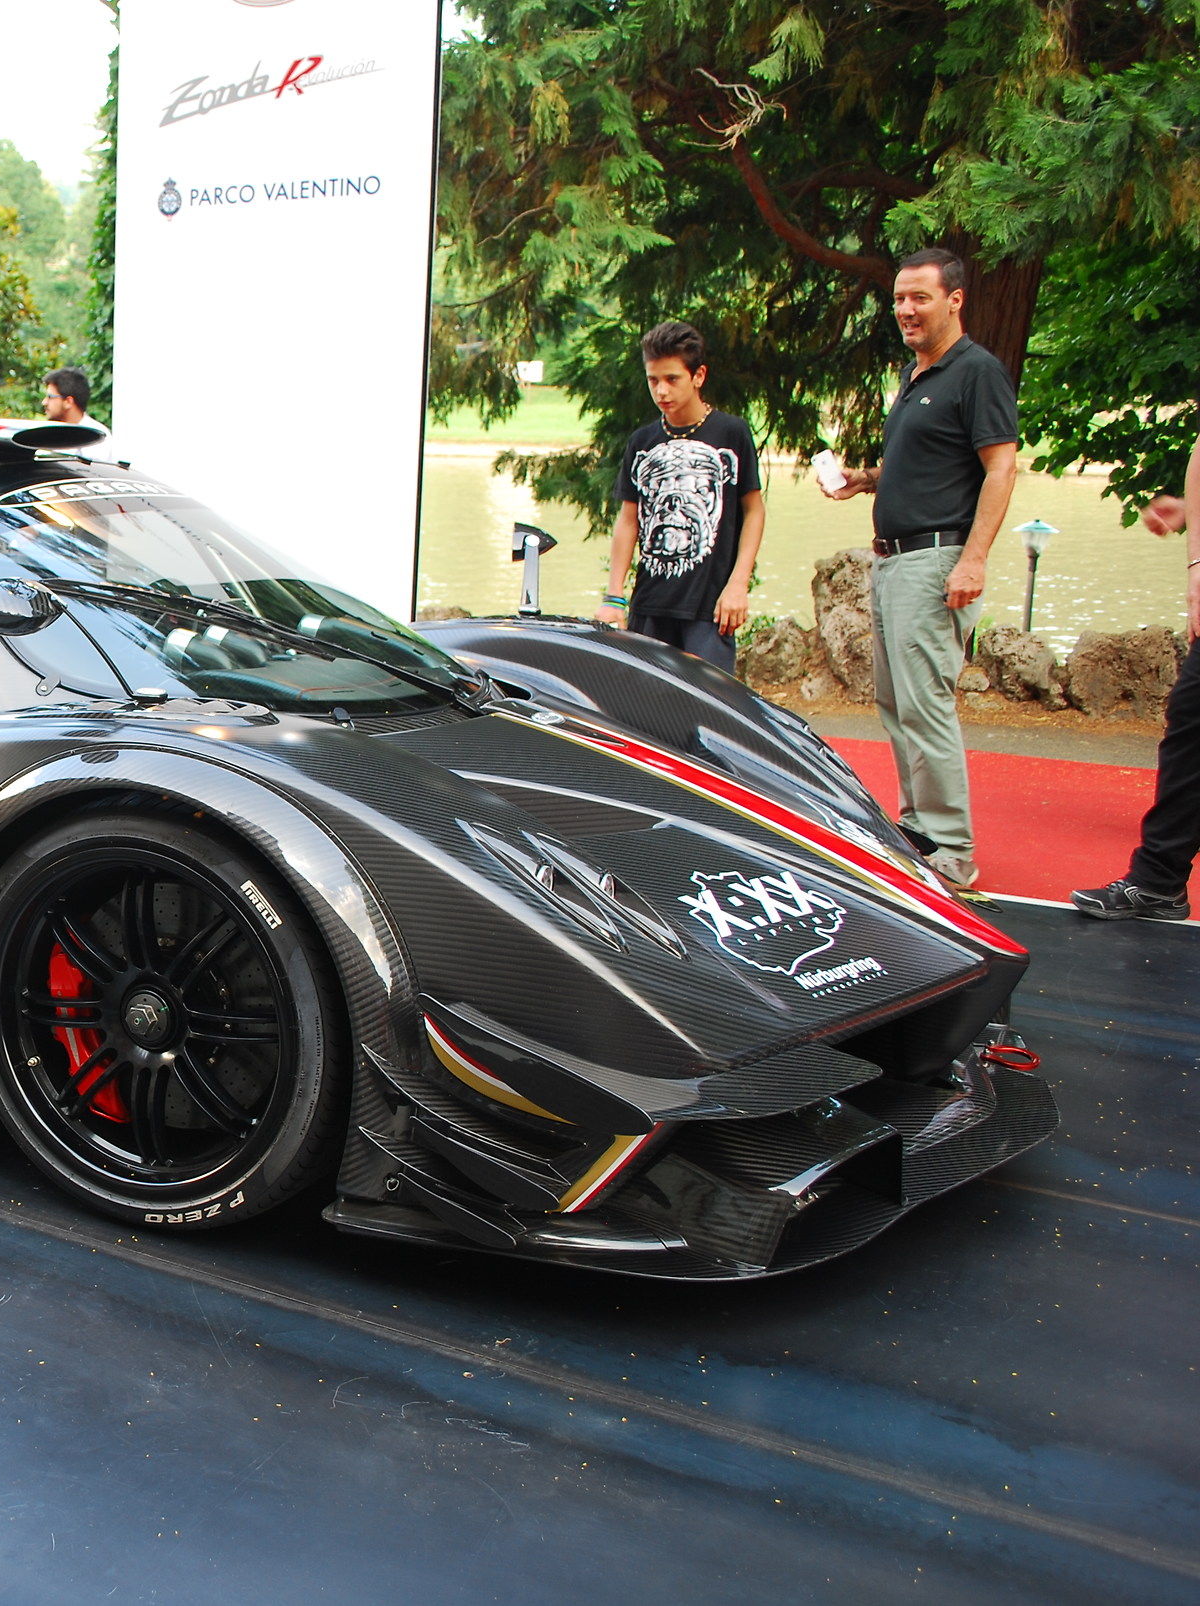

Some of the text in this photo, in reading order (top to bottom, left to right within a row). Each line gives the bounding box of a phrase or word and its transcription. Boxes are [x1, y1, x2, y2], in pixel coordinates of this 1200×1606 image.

[159, 60, 270, 128] Zonda
[190, 175, 380, 206] PARCO VALENTINO
[241, 880, 283, 930] PIRELLI
[793, 957, 882, 990] Nürburgring
[144, 1190, 245, 1224] P ZERO
